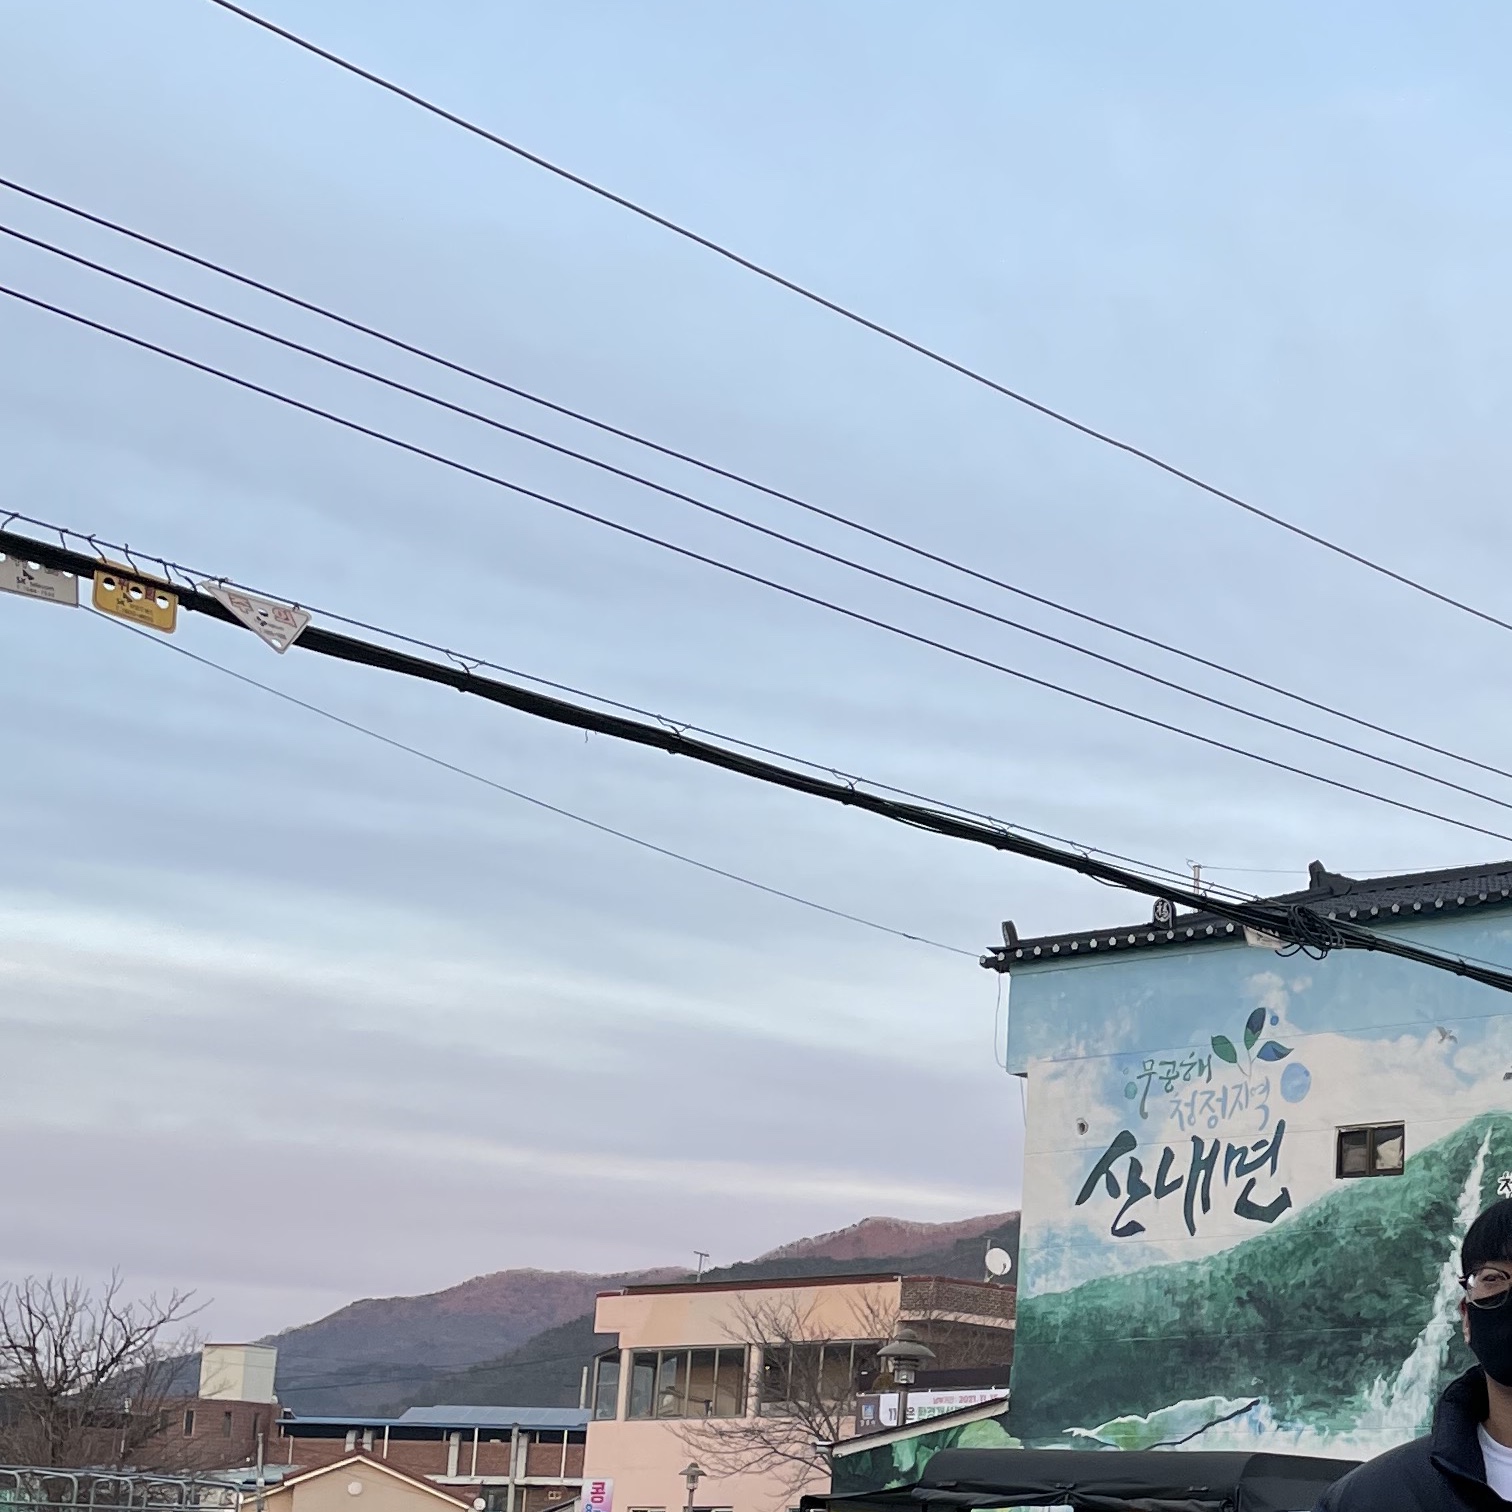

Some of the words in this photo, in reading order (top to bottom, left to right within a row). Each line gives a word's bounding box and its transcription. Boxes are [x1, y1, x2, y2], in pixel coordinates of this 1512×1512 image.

[1136, 1052, 1212, 1119] 무공해
[1169, 1076, 1271, 1131] 청정지역
[1075, 1119, 1292, 1237] 산내면
